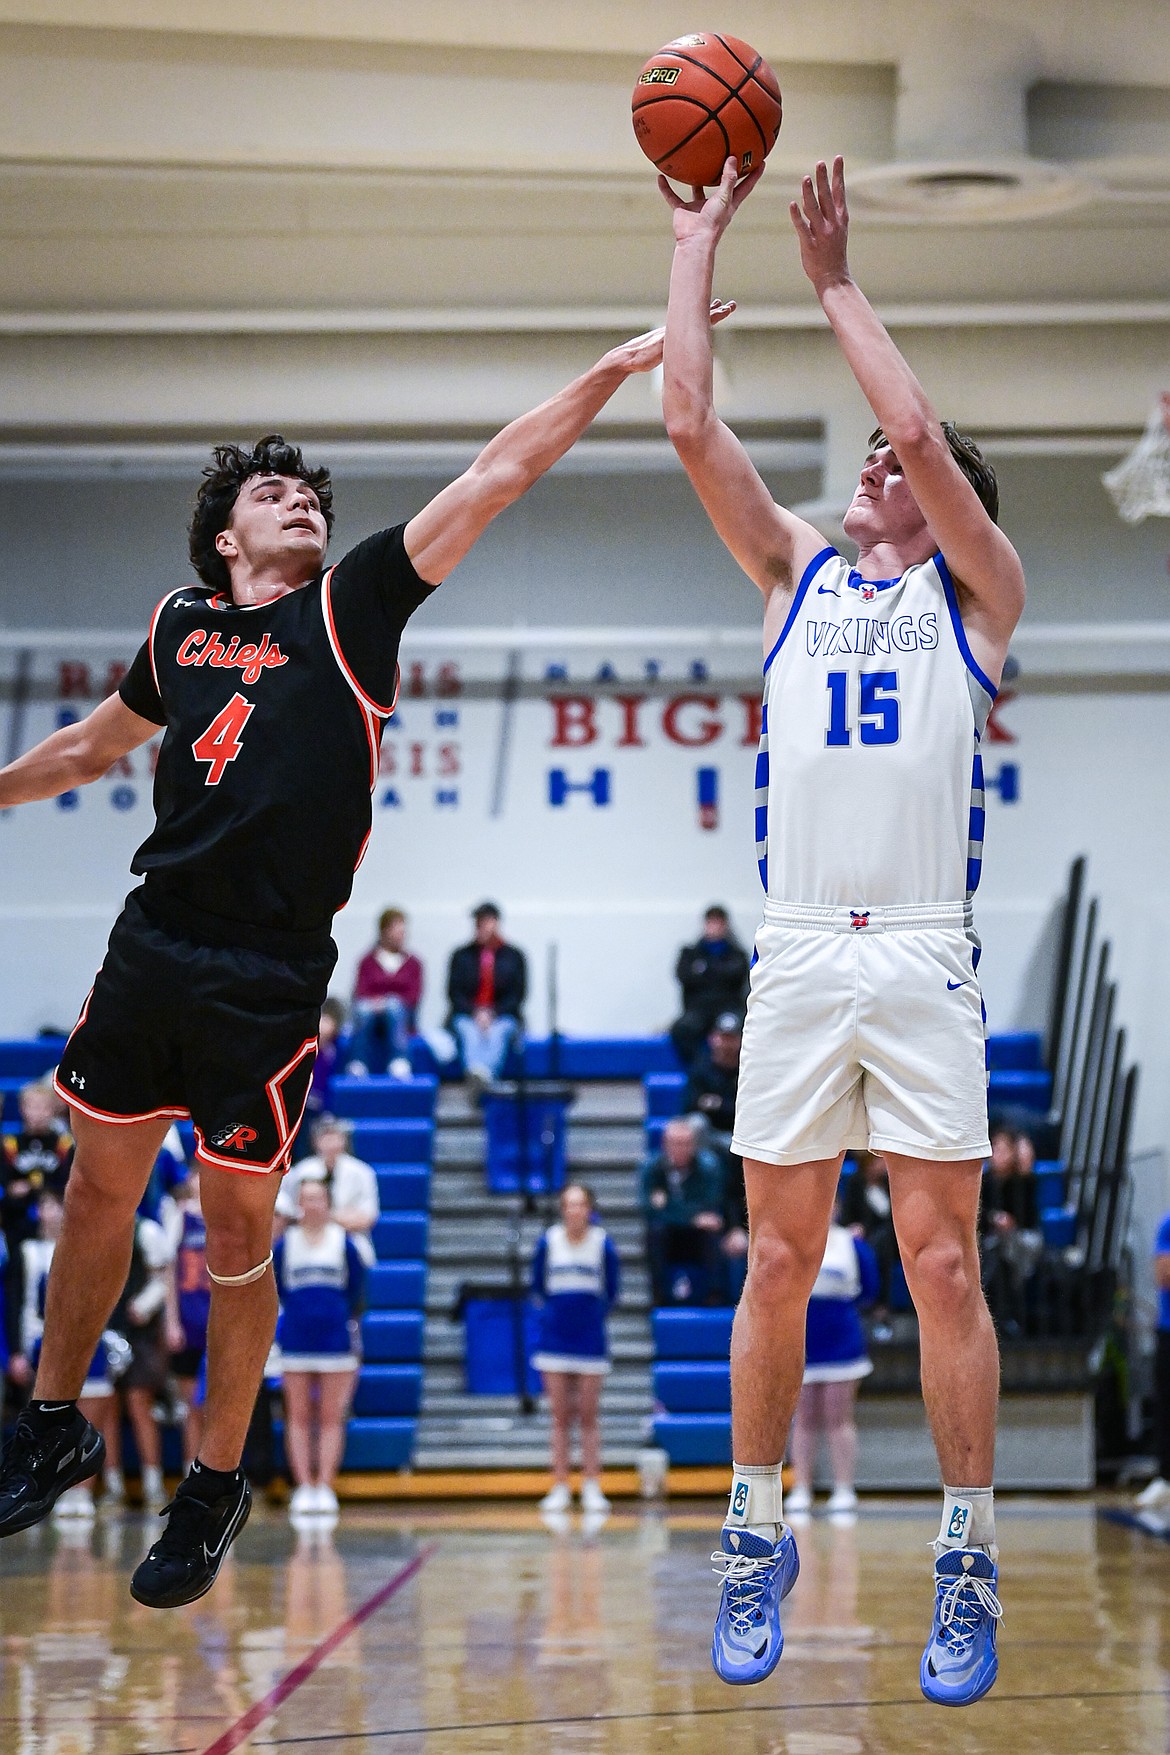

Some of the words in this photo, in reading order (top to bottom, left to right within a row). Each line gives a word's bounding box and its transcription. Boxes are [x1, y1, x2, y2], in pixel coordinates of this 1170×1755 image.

[176, 628, 290, 685] Chiefs
[807, 612, 940, 658] VIKINGS
[824, 670, 902, 749] 15
[192, 692, 256, 786] 4
[221, 1125, 259, 1151] R
